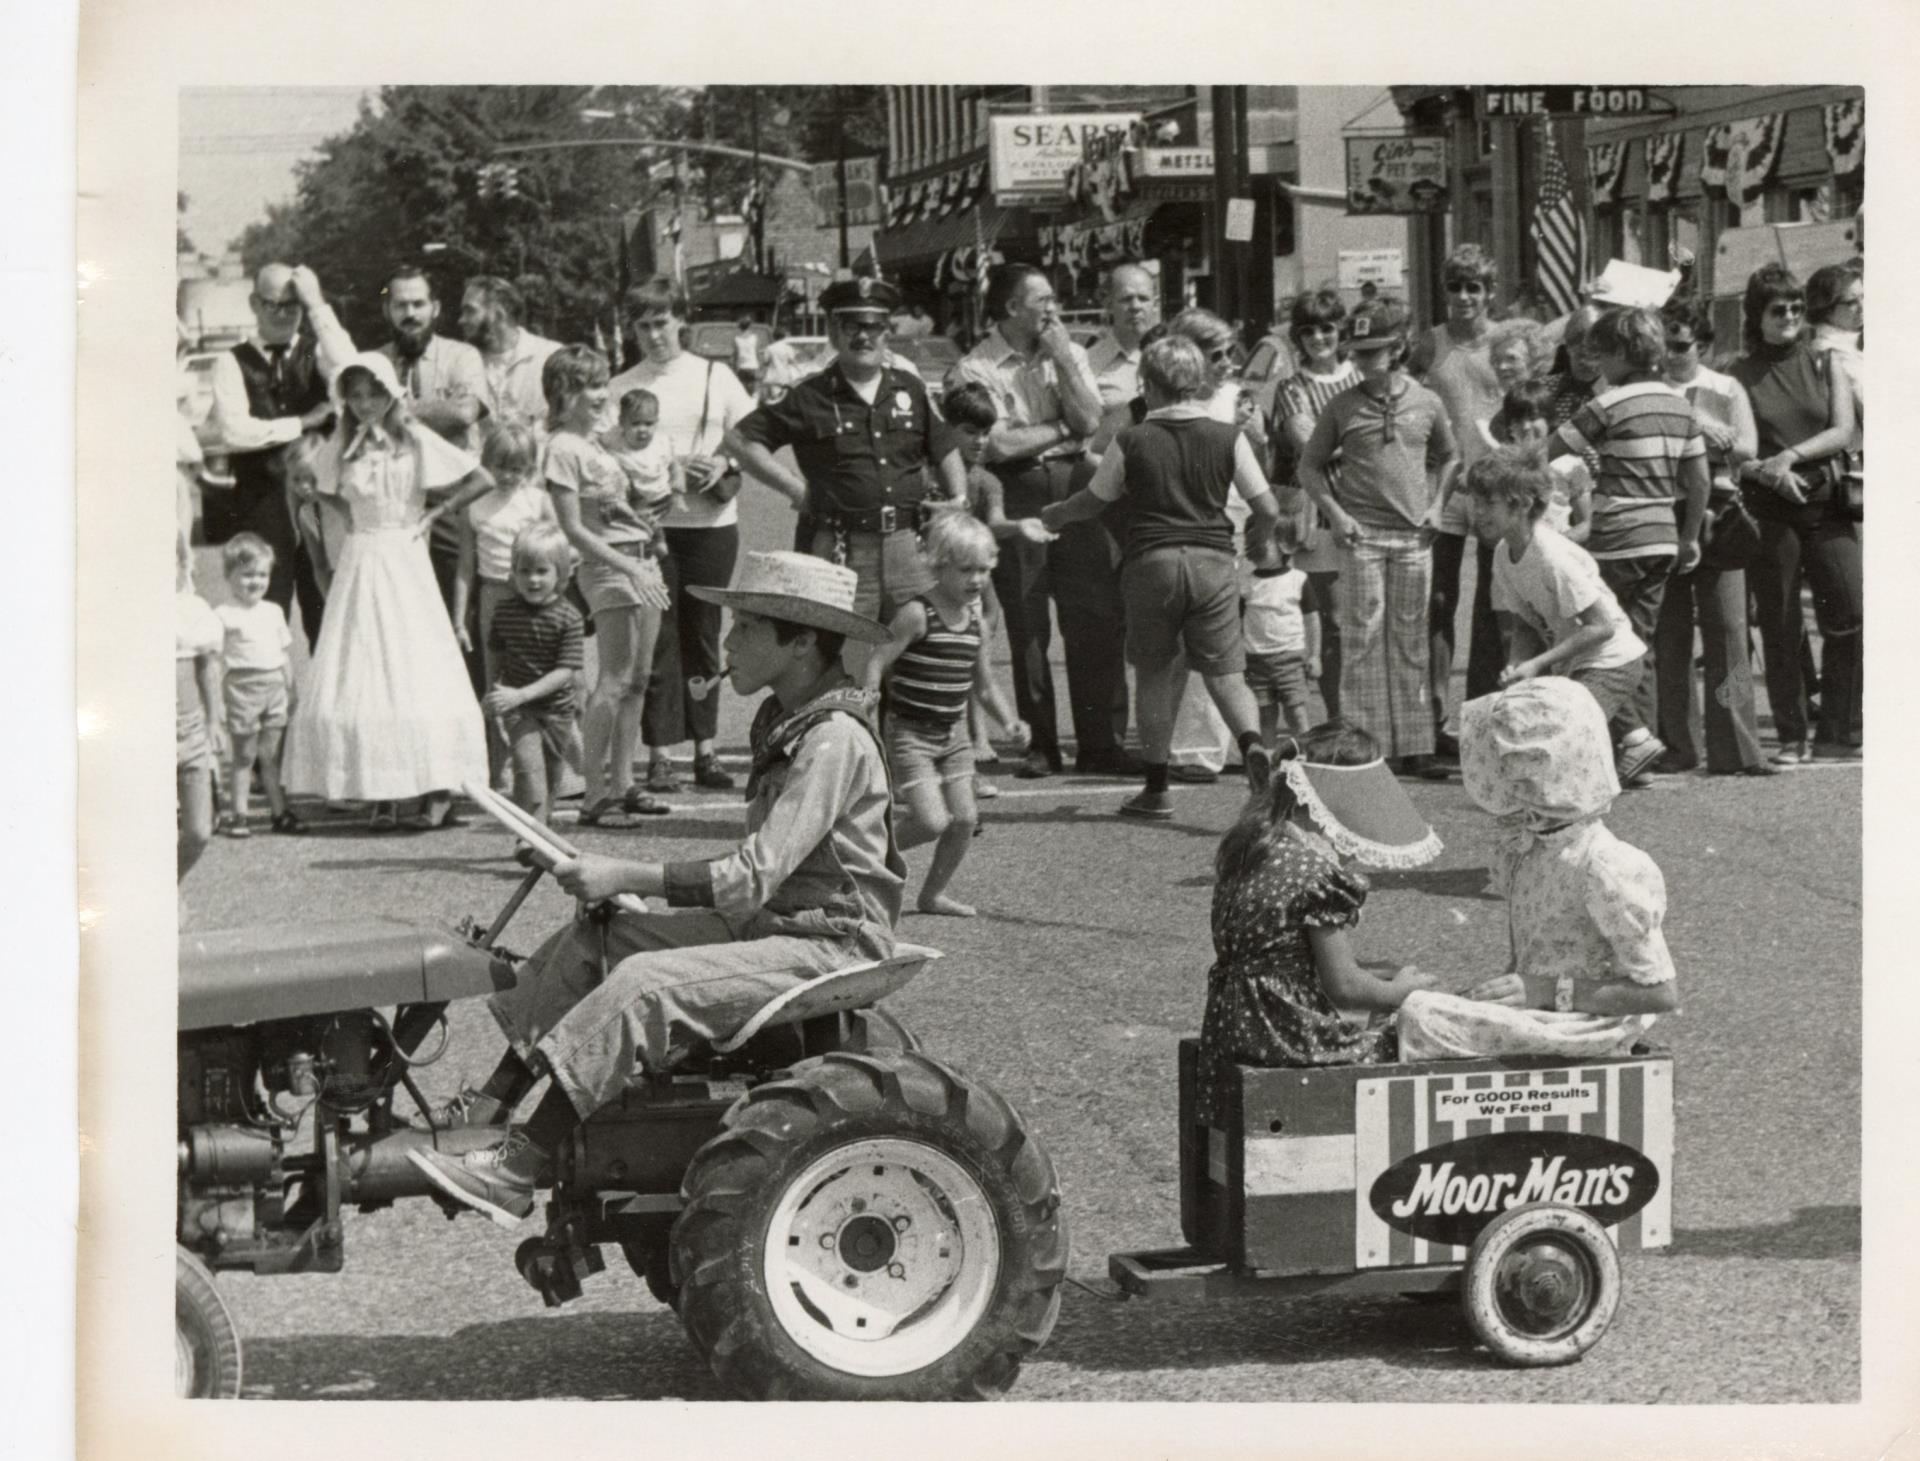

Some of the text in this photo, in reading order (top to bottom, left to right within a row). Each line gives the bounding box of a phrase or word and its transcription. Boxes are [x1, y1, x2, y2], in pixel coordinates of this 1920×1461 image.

[1487, 90, 1643, 114] FINE FOOD
[1160, 154, 1214, 169] METZL
[1442, 1088, 1590, 1105] For GOOD Results
[1479, 1102, 1553, 1115] We Feed
